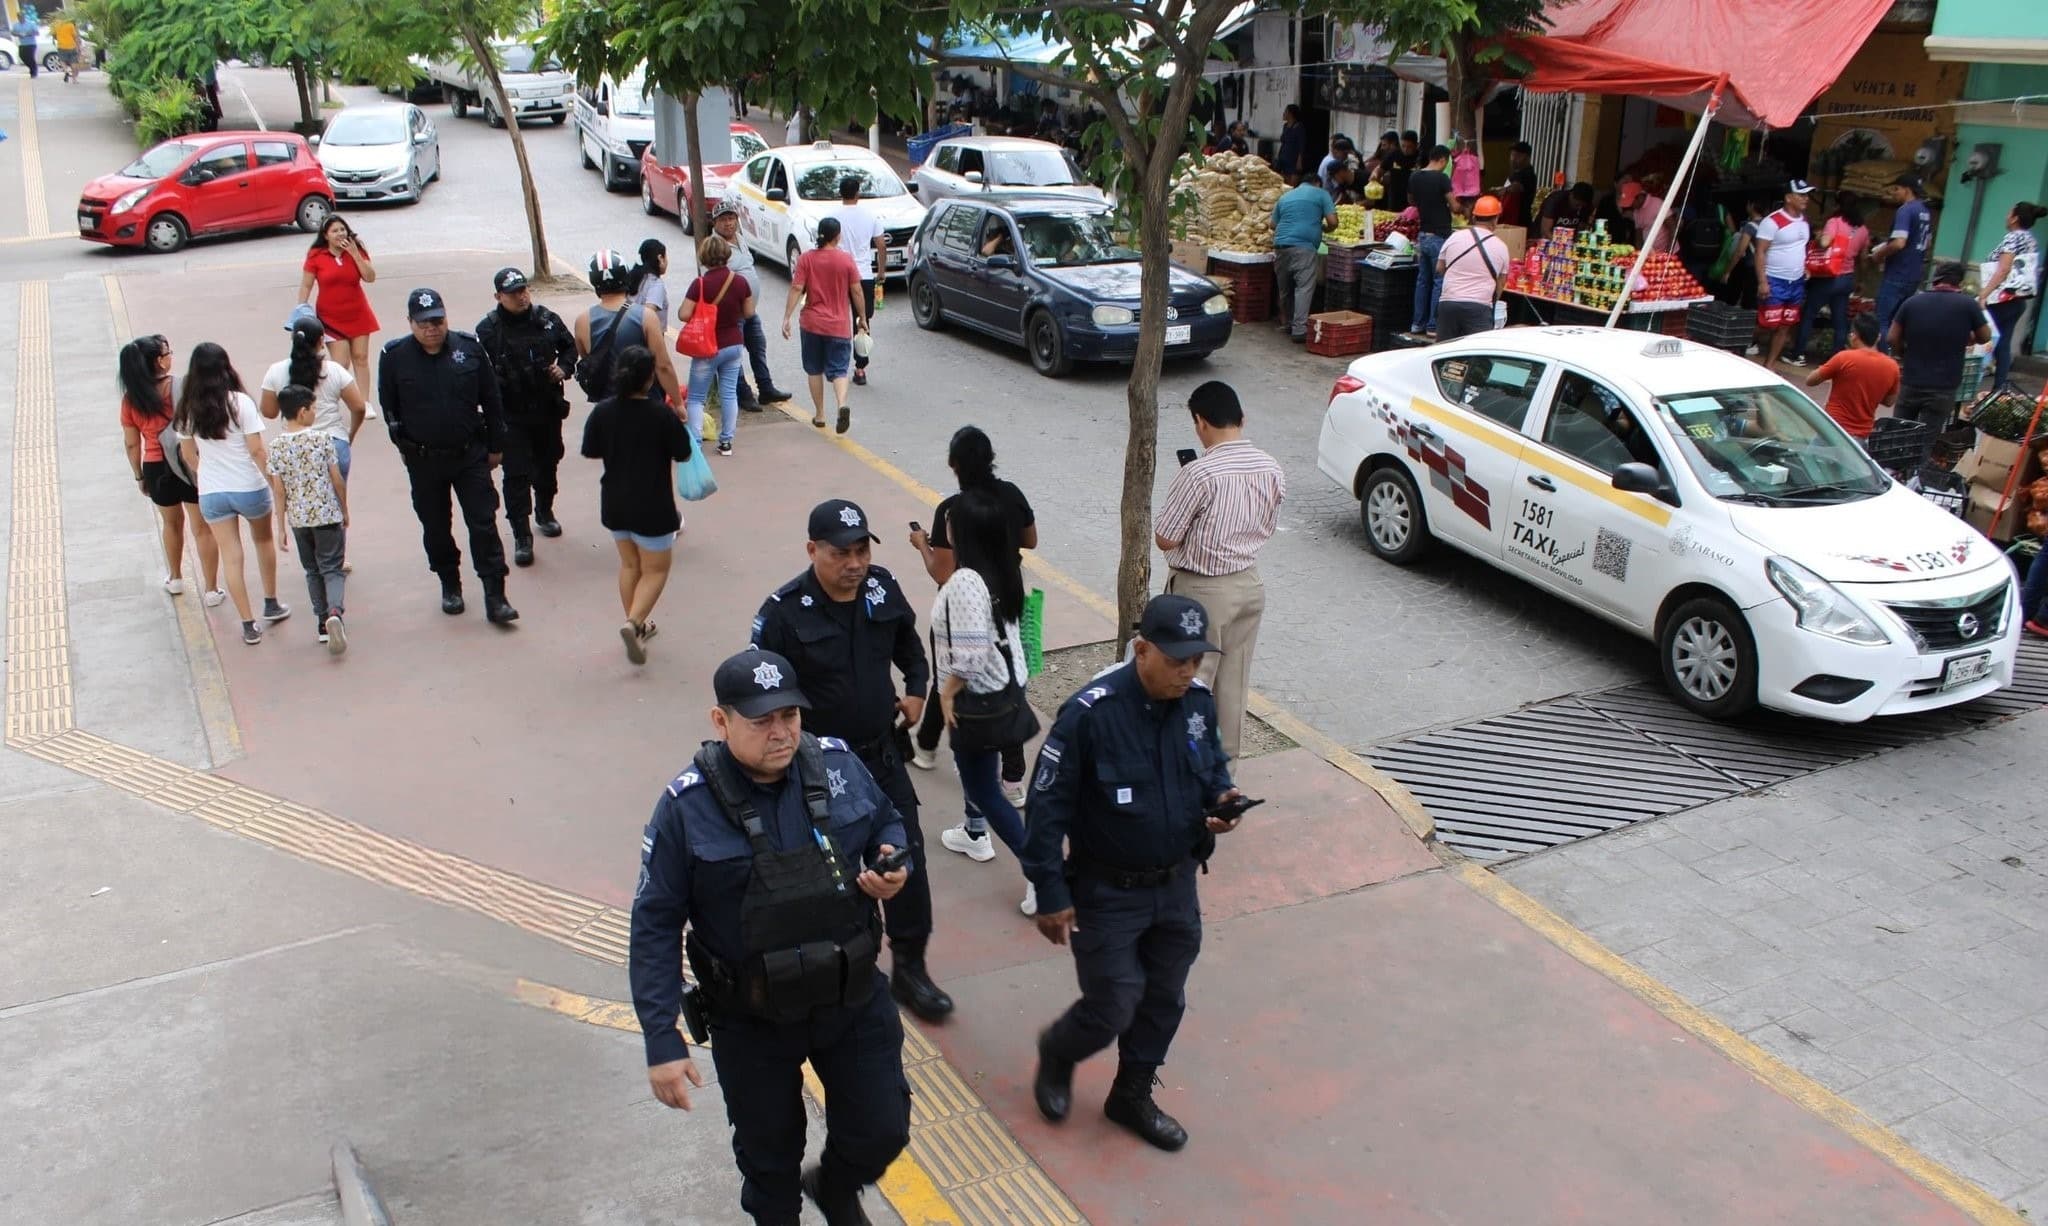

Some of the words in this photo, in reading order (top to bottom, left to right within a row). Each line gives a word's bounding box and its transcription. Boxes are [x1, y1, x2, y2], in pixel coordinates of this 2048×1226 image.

[1853, 80, 1896, 95] VENTA
[1904, 83, 1917, 97] DE
[1656, 342, 1681, 353] TAXI
[1522, 499, 1553, 528] 1581
[1513, 521, 1556, 556] TAXI
[1552, 541, 1585, 567] Especial
[1691, 541, 1735, 568] TABASCO
[1541, 561, 1549, 570] DE
[1550, 565, 1583, 586] MOVILIDAD
[1906, 550, 1953, 572] 1581
